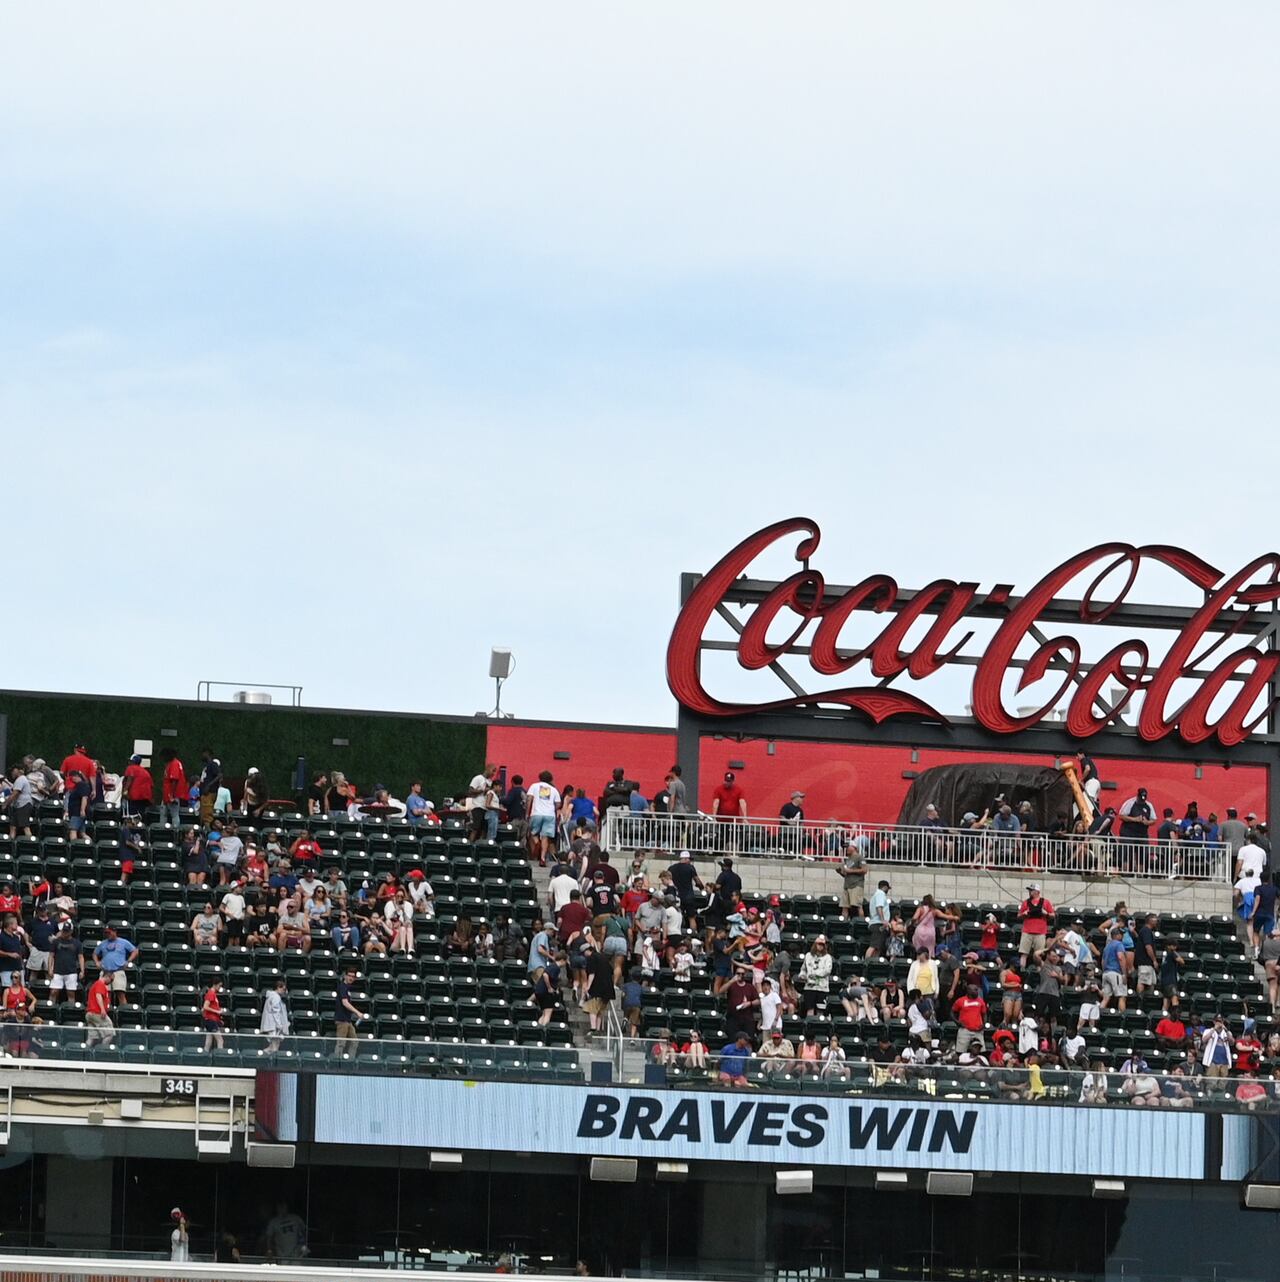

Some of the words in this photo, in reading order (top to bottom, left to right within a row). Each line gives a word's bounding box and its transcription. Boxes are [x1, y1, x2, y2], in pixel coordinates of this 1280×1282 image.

[165, 1079, 194, 1094] 345
[577, 1094, 827, 1148] BRAVES
[848, 1104, 978, 1155] WIN
